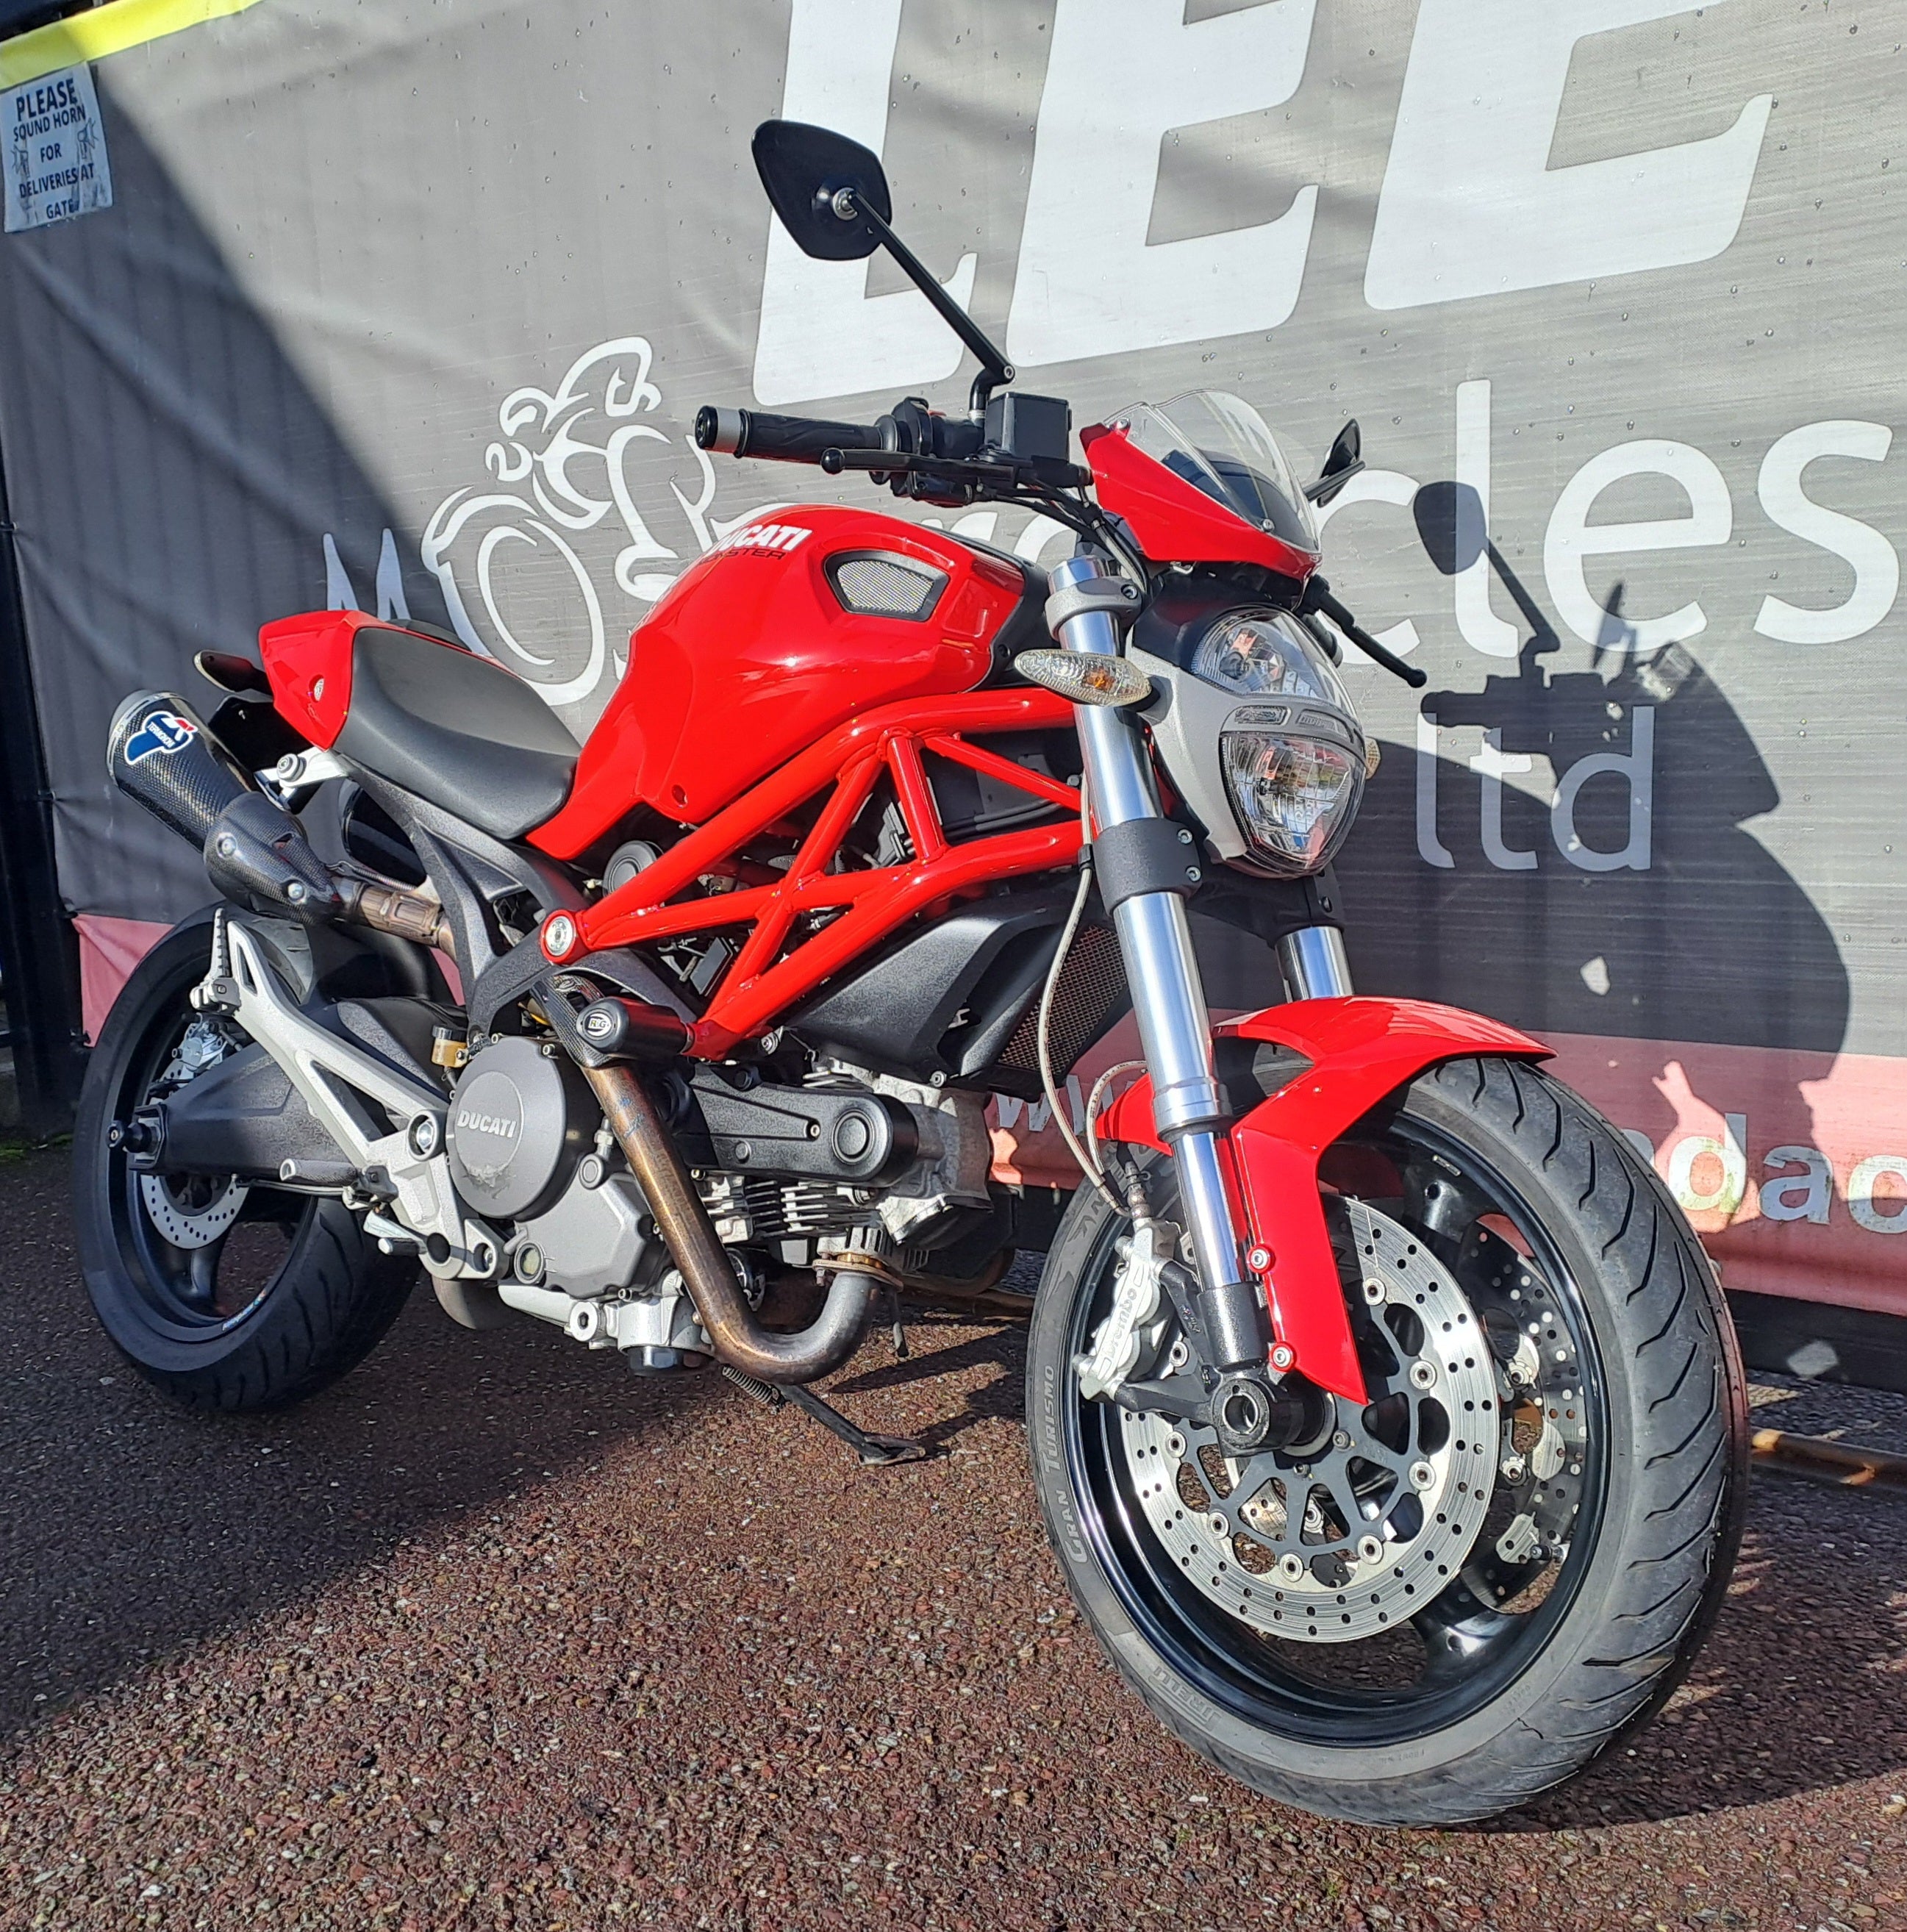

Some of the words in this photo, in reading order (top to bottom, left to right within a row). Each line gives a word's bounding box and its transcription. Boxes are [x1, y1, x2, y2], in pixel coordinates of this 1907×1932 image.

[15, 78, 78, 122] PLEASE
[13, 116, 51, 142] SOUND
[53, 104, 86, 129] HORN
[40, 143, 62, 163] FOR
[19, 167, 79, 198] DELIVERIES
[80, 162, 94, 182] AT
[46, 198, 79, 219] GATE
[1416, 705, 1655, 872] ltd
[457, 1109, 518, 1139] DUCATI
[1039, 1364, 1062, 1475] TURISMO
[1055, 1489, 1089, 1564] GRAN
[1148, 1665, 1223, 1732] PIRELLI
